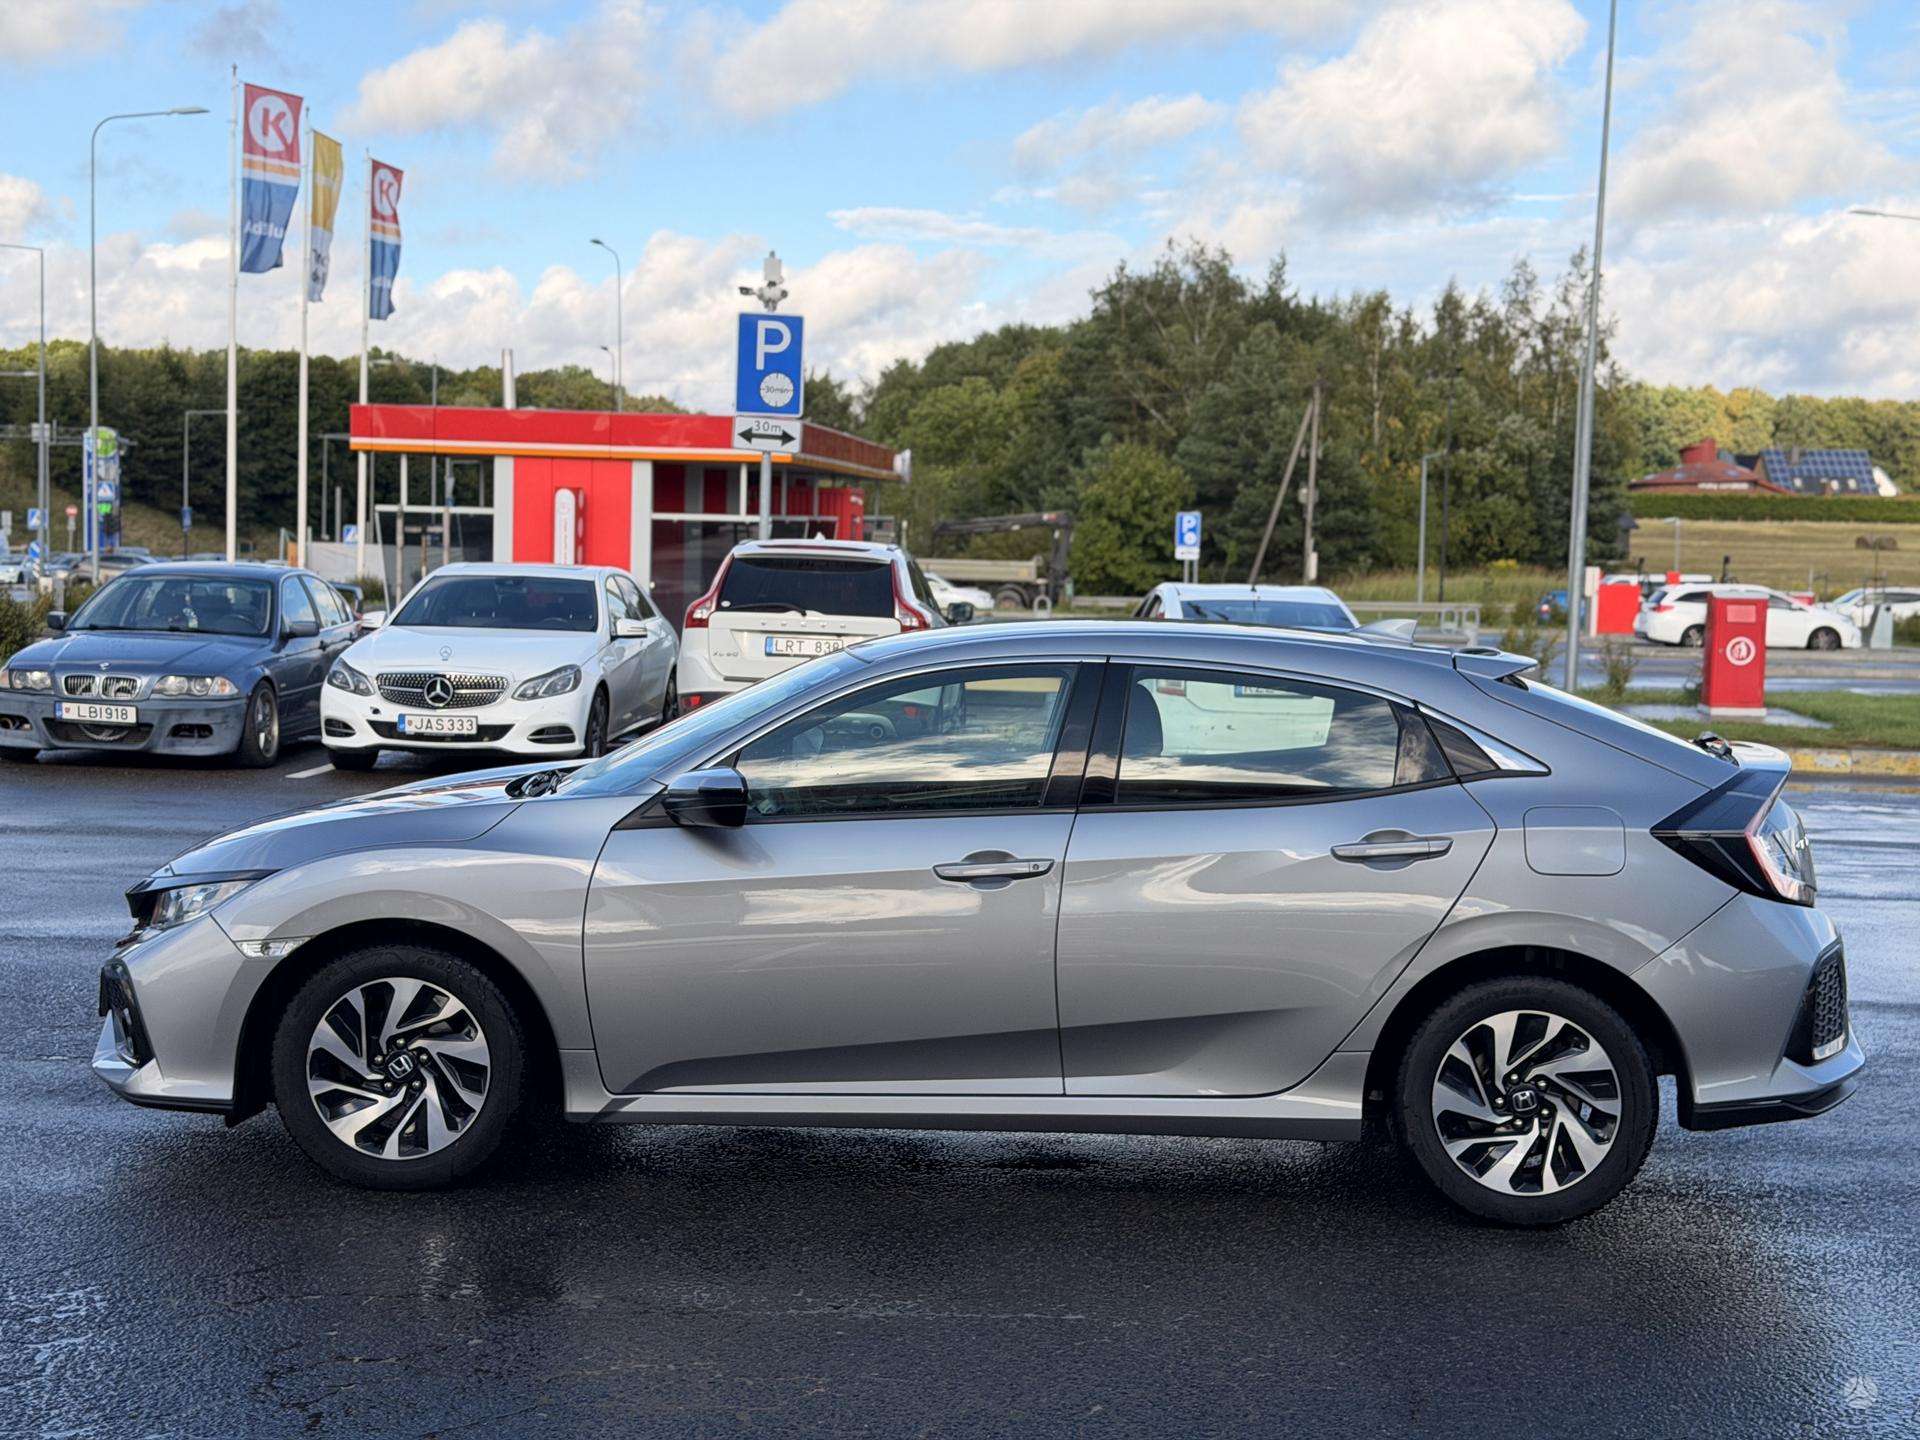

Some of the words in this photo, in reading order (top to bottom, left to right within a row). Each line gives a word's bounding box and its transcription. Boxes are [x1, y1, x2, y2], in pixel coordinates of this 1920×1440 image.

[262, 107, 290, 150] K
[756, 320, 791, 370] P
[754, 420, 782, 432] 30m
[1182, 515, 1197, 533] P
[775, 640, 804, 653] LRT
[415, 718, 474, 731] JAS333
